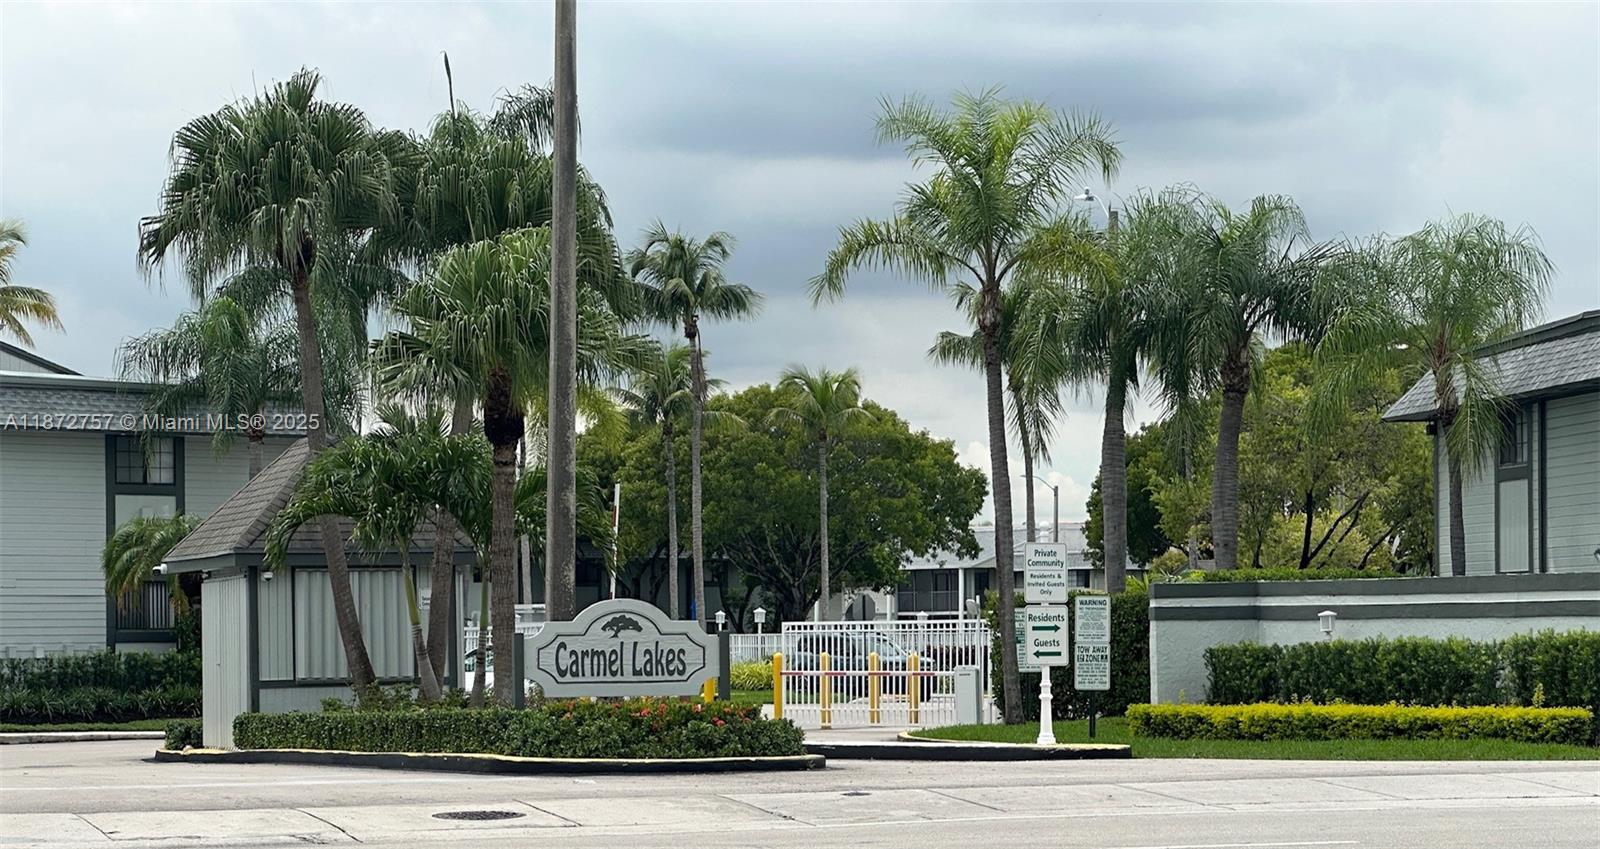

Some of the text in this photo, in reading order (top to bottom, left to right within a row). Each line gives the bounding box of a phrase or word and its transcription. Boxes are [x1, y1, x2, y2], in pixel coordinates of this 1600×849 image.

[1034, 549, 1057, 557] Private
[1027, 559, 1064, 568] Community
[1028, 613, 1065, 622] Residents
[1034, 638, 1060, 647] Guests
[555, 640, 687, 678] Carmel Lakes
[1085, 654, 1100, 662] ZONE
